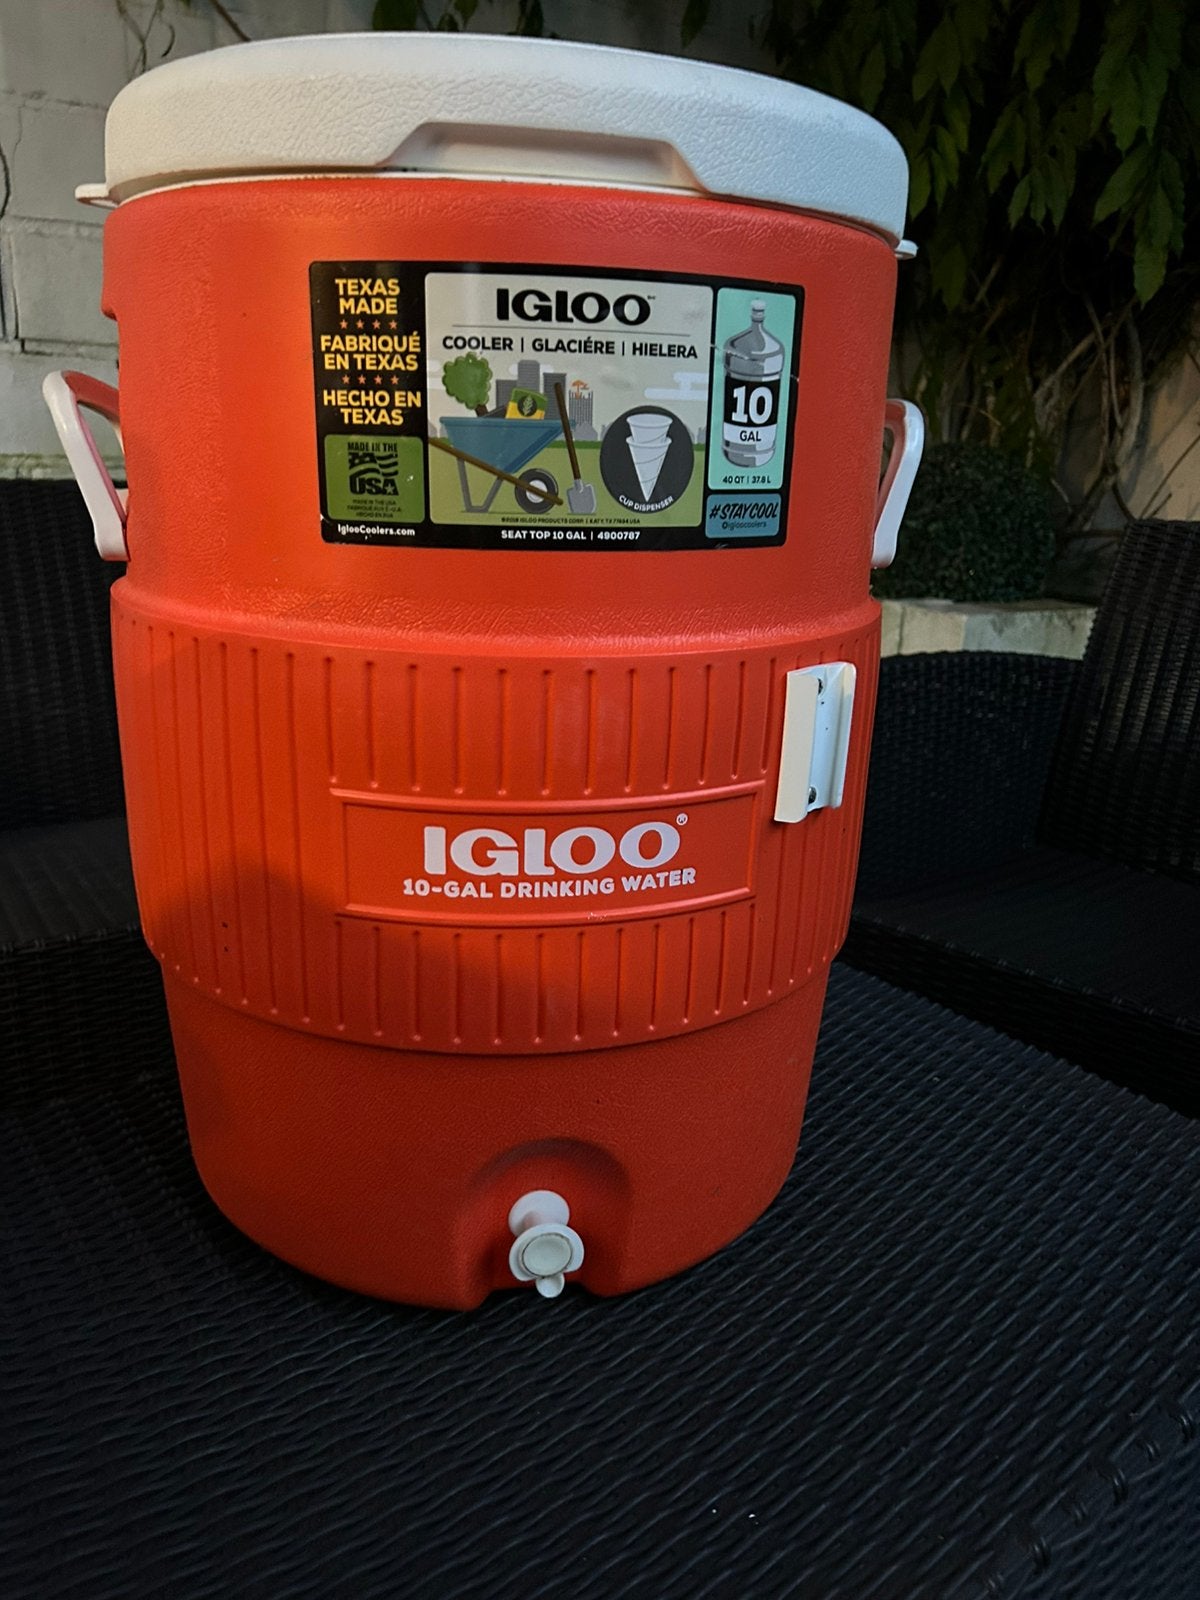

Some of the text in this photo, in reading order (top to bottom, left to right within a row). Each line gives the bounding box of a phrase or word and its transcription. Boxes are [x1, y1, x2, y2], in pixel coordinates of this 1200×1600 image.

[335, 278, 400, 296] TEXAS
[339, 298, 398, 315] MADE
[496, 288, 651, 326] IGLOO
[320, 331, 421, 353] FABRIQUÉ
[442, 335, 698, 359] COOLER GLACIÉRE HIELERA
[324, 353, 418, 371] EN TEXAS
[323, 389, 422, 408] HECHO EN
[731, 385, 773, 425] 10
[340, 408, 404, 426] TEXAS
[739, 429, 762, 442] GAL
[347, 442, 398, 452] MADE IN THE
[349, 477, 399, 496] USA
[722, 475, 733, 484] 40
[734, 475, 745, 484] QT
[767, 475, 771, 484] L
[619, 494, 674, 511] CUP DISPENSER
[709, 502, 779, 520] #STAYCOOL
[337, 523, 415, 536] IglooCoolers.com
[501, 529, 528, 539] SEAT
[529, 529, 551, 540] TOP
[552, 530, 564, 540] 10
[566, 530, 587, 540] GAL
[424, 821, 681, 876] IGLOO
[403, 867, 697, 899] 10-GAL DRINKING WATER
